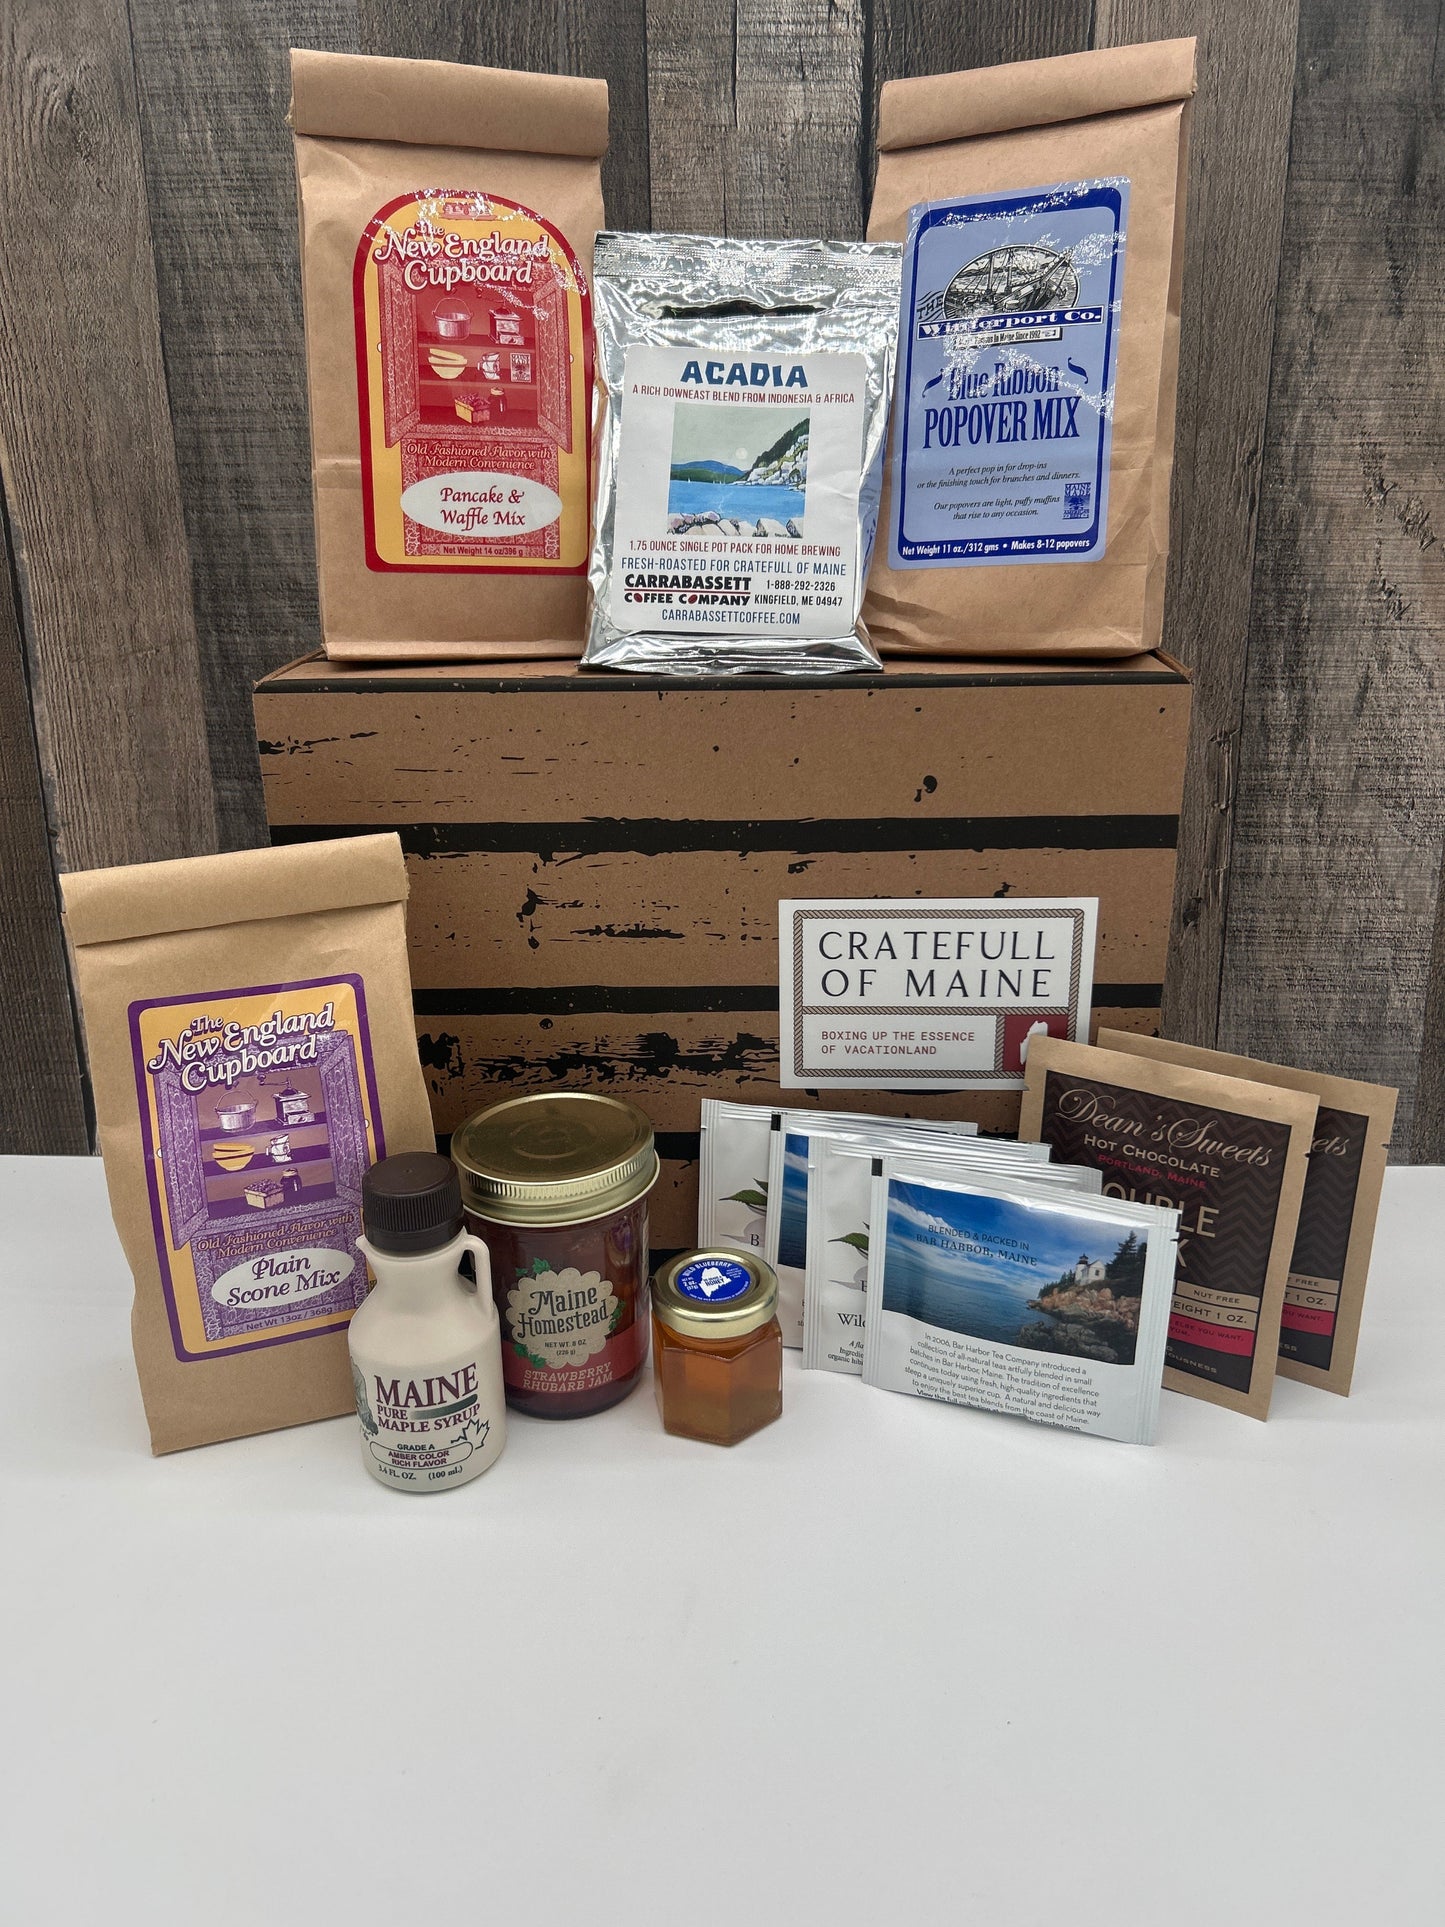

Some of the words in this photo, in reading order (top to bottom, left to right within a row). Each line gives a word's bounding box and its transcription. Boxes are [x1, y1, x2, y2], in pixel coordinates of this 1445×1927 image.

[375, 228, 442, 260] New
[445, 232, 551, 261] England
[405, 260, 533, 290] Cupboard
[918, 296, 943, 319] THE
[1064, 309, 1100, 321] Co.
[681, 361, 808, 388] ACADIA
[633, 384, 638, 394] A
[642, 386, 660, 395] RICH
[663, 387, 710, 400] DOWNEAST
[713, 391, 739, 401] BLEND
[743, 393, 765, 402] FROM
[768, 394, 813, 403] INDONESIA
[816, 394, 821, 403] &
[824, 393, 854, 403] AFRICA
[923, 400, 1027, 449] POPOVER
[1032, 396, 1081, 441] MIX
[407, 443, 427, 454] Old
[430, 443, 488, 457] Fashioned
[490, 446, 525, 458] Flavor
[526, 448, 550, 458] with
[424, 455, 467, 467] Modern
[471, 458, 535, 470] Convenience
[949, 467, 955, 475] A
[956, 465, 979, 476] perfect
[981, 464, 995, 474] pop
[1004, 463, 1015, 473] for
[1018, 462, 1047, 472] drop-ins
[926, 480, 937, 488] the
[938, 478, 968, 489] finishing
[969, 477, 987, 485] touch
[989, 475, 1001, 486] for
[1003, 474, 1034, 483] brunches
[1052, 471, 1080, 479] dinners.
[440, 485, 504, 503] Pancake
[508, 488, 525, 503] &
[440, 507, 488, 531] Waffle
[494, 510, 526, 525] Mix
[458, 547, 482, 555] Weight
[630, 541, 647, 551] 1.75
[650, 541, 676, 552] OUNCE
[680, 542, 708, 553] SINGLE
[712, 542, 728, 553] POT
[731, 543, 752, 554] PACK
[756, 544, 772, 554] FOR
[775, 544, 798, 555] HOME
[802, 545, 840, 556] BREWING
[902, 546, 915, 555] Net
[917, 544, 940, 555] Weight
[942, 544, 950, 552] 11
[953, 542, 982, 553] oz./312
[984, 543, 999, 553] gms
[1011, 539, 1034, 550] Makes
[1037, 539, 1054, 548] 8-12
[1056, 538, 1089, 550] popovers
[622, 558, 706, 571] FRESH-ROASTED
[711, 560, 729, 572] FOR
[734, 560, 792, 574] CRATEFULL
[797, 562, 809, 574] OF
[813, 563, 846, 576] MAINE
[625, 574, 751, 591] CARRABASSETT
[767, 580, 835, 591] 1-888-292-2326
[755, 596, 799, 606] KINGFIELD,
[802, 596, 813, 606] ME
[816, 597, 843, 606] 04947
[662, 609, 800, 625] CARRABASSETTCOFFEE.COM
[819, 931, 1055, 960] CRATEFULL
[821, 969, 877, 997] OF
[905, 969, 1051, 997] MAINE
[192, 1016, 223, 1032] The
[149, 1030, 219, 1069] New
[224, 1003, 334, 1050] England
[821, 1032, 867, 1041] BOXING
[873, 1032, 887, 1041] UP
[894, 1032, 915, 1041] THE
[921, 1032, 975, 1042] ESSENCE
[822, 1045, 836, 1054] OF
[845, 1045, 937, 1055] VACATIONLAND
[181, 1034, 317, 1091] Cupboard
[1056, 1089, 1167, 1142] Dean's
[1168, 1118, 1273, 1167] Sweets
[1084, 1134, 1120, 1149] HOT
[1123, 1144, 1220, 1178] CHOCOLATE
[1097, 1154, 1163, 1178] PORTLAND,
[1168, 1172, 1206, 1189] MAINE
[197, 1238, 220, 1251] Old
[223, 1227, 284, 1247] Fashioned
[289, 1220, 324, 1234] Flavor
[328, 1213, 353, 1226] with
[928, 1225, 970, 1239] BLENDED
[973, 1233, 978, 1241] &
[982, 1234, 1017, 1248] PACKED
[216, 1242, 264, 1259] Modern
[267, 1228, 337, 1249] Convenience
[917, 1234, 936, 1246] BAR
[941, 1239, 993, 1258] HARBOR,
[999, 1250, 1037, 1266] MAINE
[252, 1255, 310, 1280] Plain
[695, 1261, 732, 1269] BLUEBERRY
[227, 1282, 289, 1306] Scone
[296, 1270, 340, 1291] Mix
[1296, 1279, 1319, 1287] FREE
[529, 1288, 597, 1316] Maine
[1194, 1290, 1212, 1299] NUT
[1217, 1296, 1240, 1304] FREE
[1306, 1297, 1327, 1306] OZ.
[246, 1322, 263, 1331] Net
[264, 1319, 278, 1328] Wt
[280, 1314, 301, 1324] 13oz
[310, 1308, 332, 1318] 368g
[517, 1299, 608, 1339] Homestead
[1173, 1302, 1211, 1318] EIGHT
[1227, 1314, 1247, 1324] OZ.
[933, 1336, 950, 1348] 2006,
[953, 1341, 964, 1350] Bar
[966, 1344, 990, 1357] Harbor
[992, 1350, 1003, 1360] Tea
[1005, 1354, 1040, 1368] Company
[1041, 1361, 1080, 1374] introduced
[524, 1362, 611, 1381] STRAWBERRY
[374, 1362, 479, 1408] MAINE
[523, 1379, 585, 1391] RHUBARB
[589, 1373, 612, 1388] JAM
[377, 1405, 408, 1419] PURE
[378, 1416, 430, 1432] MAPLE
[434, 1403, 481, 1431] SYRUP
[388, 1451, 417, 1460] AMBER
[419, 1450, 449, 1460] COLOR
[392, 1459, 410, 1467] RICH
[413, 1458, 446, 1467] FLAVOR
[428, 1471, 445, 1480] (100
